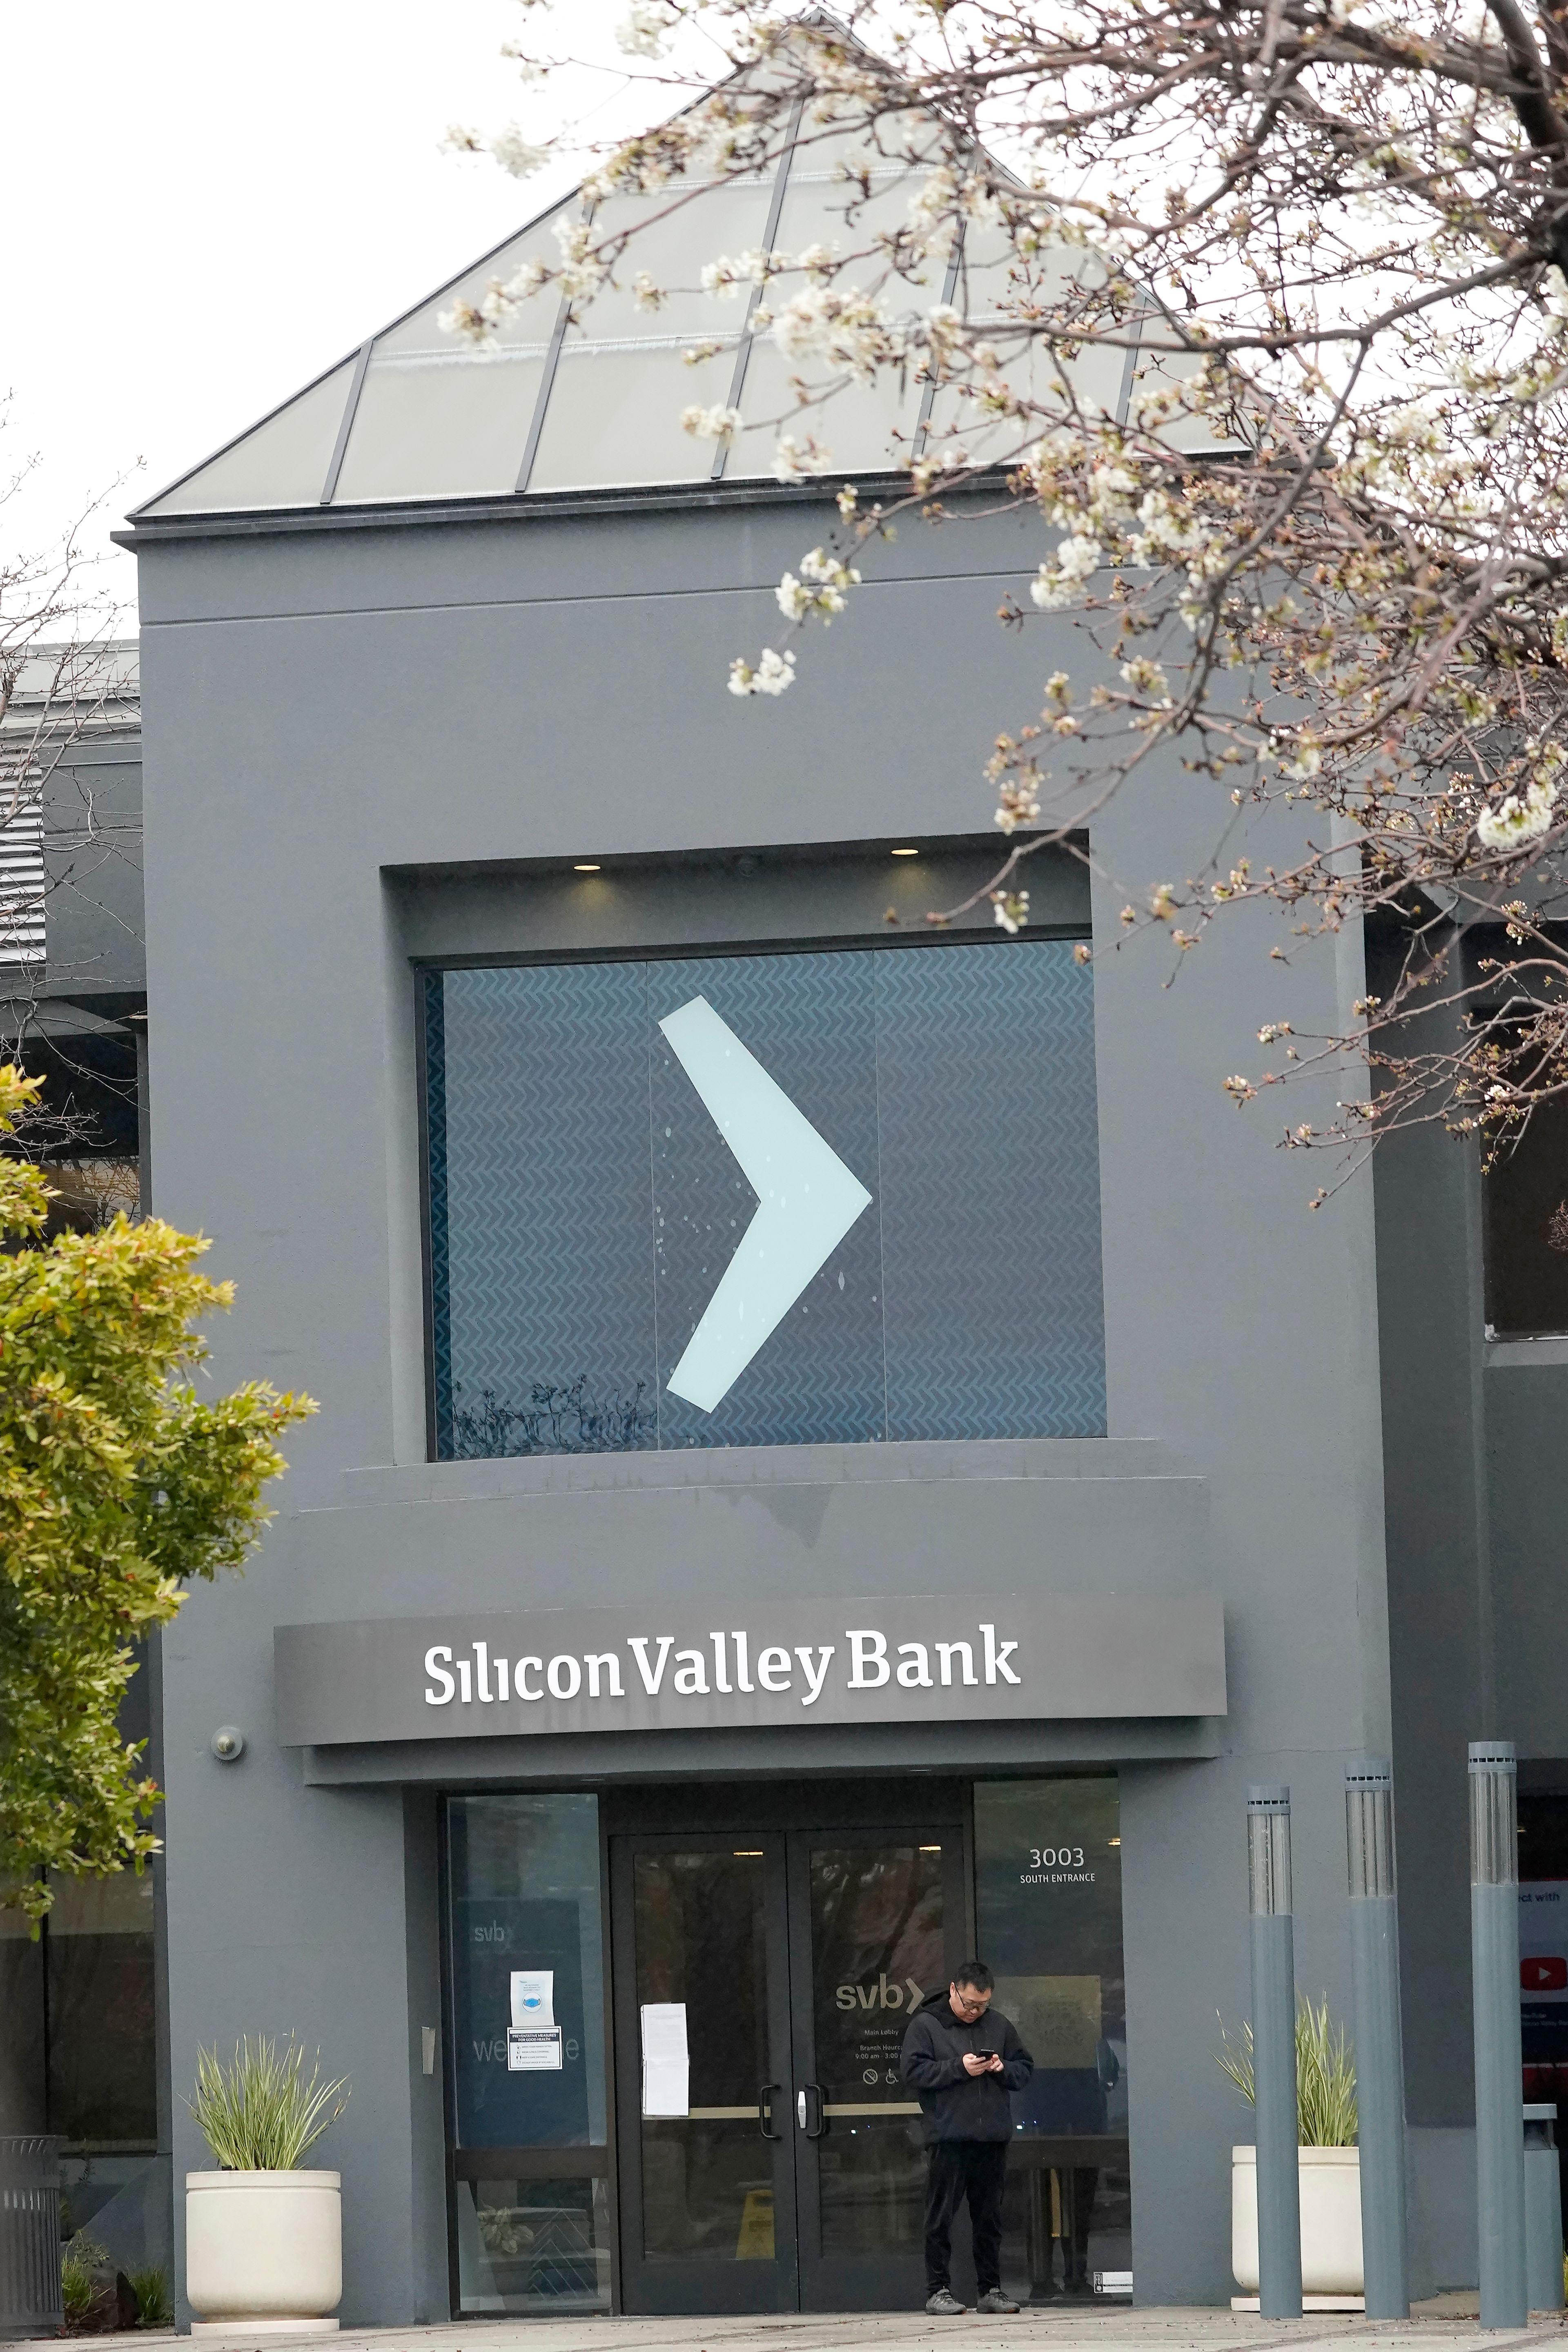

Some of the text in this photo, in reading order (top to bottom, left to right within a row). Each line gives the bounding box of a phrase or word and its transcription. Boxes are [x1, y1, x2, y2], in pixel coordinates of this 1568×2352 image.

[627, 1631, 835, 1706] Valley
[845, 1624, 1021, 1689] Bank
[1029, 1848, 1084, 1868] 3003
[1020, 1873, 1095, 1884] SOUTH ENTRANCE
[474, 1920, 505, 1941] svb
[836, 1973, 904, 2010] svb
